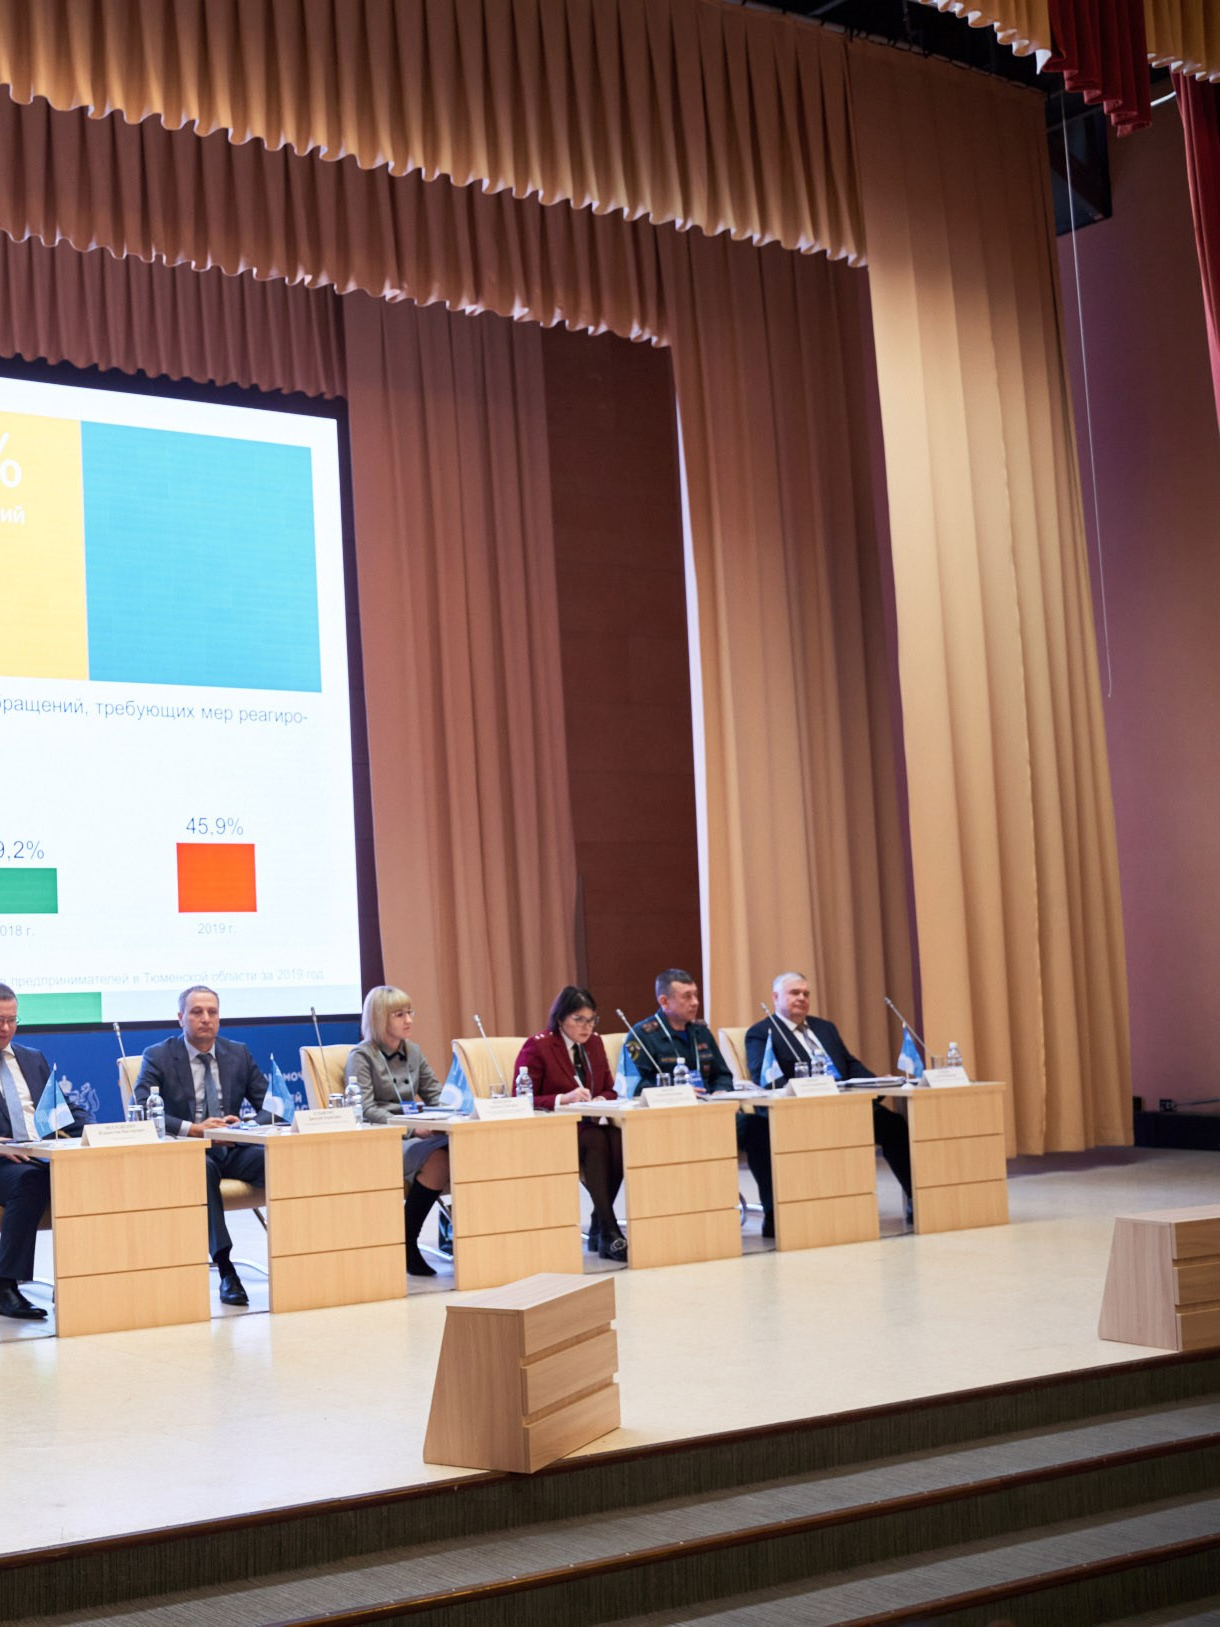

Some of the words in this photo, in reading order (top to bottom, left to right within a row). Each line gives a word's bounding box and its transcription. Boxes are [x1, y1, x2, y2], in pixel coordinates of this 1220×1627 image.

[95, 702, 196, 722] требующих
[201, 707, 233, 725] мер
[238, 708, 308, 726] реагиро-
[186, 817, 244, 836] 45,9%
[197, 922, 228, 935] 2019
[11, 973, 129, 989] предпринимателей
[134, 977, 140, 985] в
[144, 969, 208, 984] Тюменской
[212, 969, 257, 983] области
[261, 971, 274, 980] за
[278, 968, 303, 980] 2019
